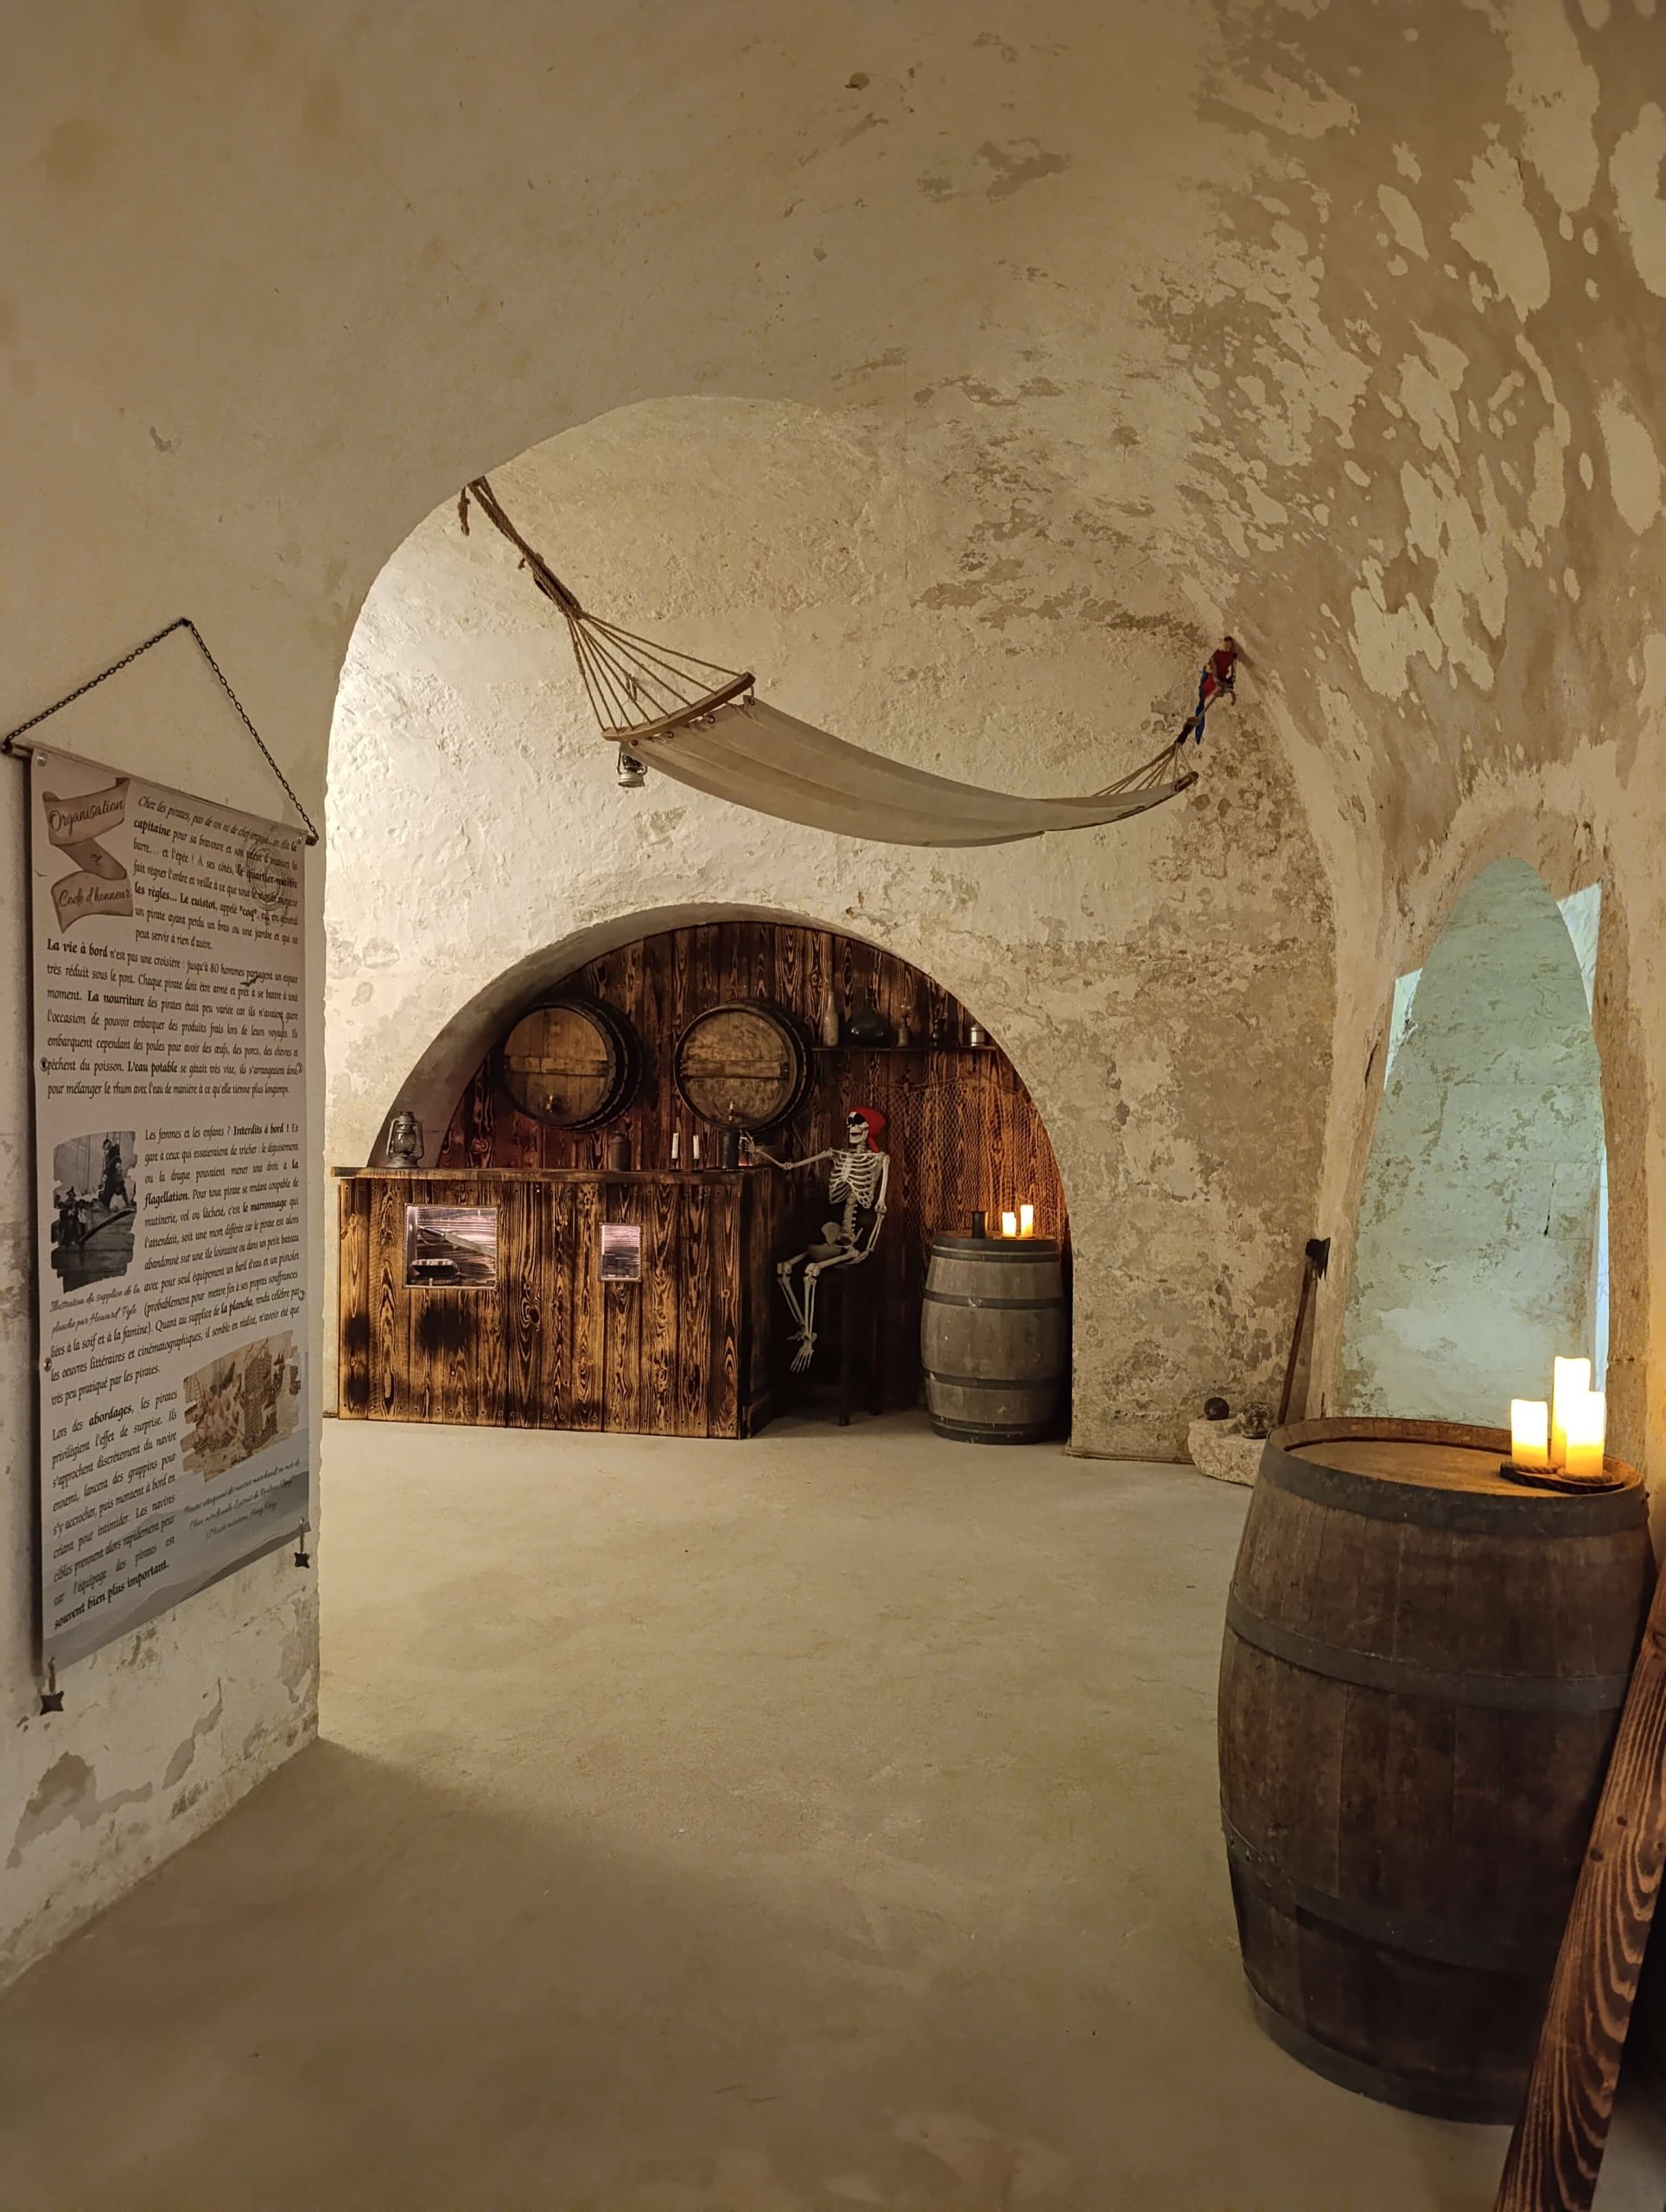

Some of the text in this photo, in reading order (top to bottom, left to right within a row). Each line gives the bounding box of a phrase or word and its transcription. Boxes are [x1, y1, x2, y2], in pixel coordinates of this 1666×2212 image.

[49, 800, 124, 836] Organisation
[134, 820, 169, 836] capitaine
[172, 831, 187, 842] pour
[199, 835, 223, 851] bravoure
[234, 847, 243, 857] son
[91, 854, 103, 866] et
[60, 887, 84, 906] Code
[135, 883, 144, 894] les
[180, 893, 188, 904] Le
[136, 930, 149, 942] peut
[151, 931, 169, 942] servir
[176, 935, 188, 944] rien
[191, 936, 212, 949] d'autre.
[47, 938, 60, 950] La
[62, 941, 77, 952] vie
[89, 944, 108, 957] bord
[110, 949, 124, 960] n'est
[127, 953, 137, 965] pas
[187, 960, 207, 975] jusqu'à
[210, 963, 217, 973] 80
[221, 963, 244, 976] hommes
[48, 989, 81, 1000] moment.
[87, 990, 99, 1001] La
[104, 995, 143, 1006] nourriture
[148, 995, 156, 1007] des
[161, 999, 181, 1013] pirates
[185, 1001, 198, 1011] était
[202, 1005, 212, 1016] peu
[48, 1009, 86, 1023] l'occasion
[92, 1013, 99, 1025] de
[104, 1017, 129, 1030] pouvoir
[133, 1017, 164, 1033] embarquer
[169, 1019, 177, 1030] des
[181, 1020, 206, 1035] produits
[209, 1021, 223, 1037] frais
[227, 1023, 237, 1034] lors
[251, 1025, 264, 1035] leurs
[48, 1034, 92, 1052] embarquent
[97, 1037, 130, 1052] cependant
[133, 1038, 143, 1050] des
[146, 1039, 164, 1054] poules
[168, 1044, 181, 1056] pour
[184, 1044, 199, 1052] avoir
[202, 1042, 212, 1052] des
[232, 1044, 241, 1054] des
[48, 1085, 64, 1098] pour
[67, 1082, 102, 1098] mélanger
[113, 1082, 130, 1093] rhum
[149, 1082, 162, 1093] l'eau
[173, 1084, 197, 1093] manière
[213, 1083, 231, 1097] qu'elle
[252, 1083, 263, 1096] plus
[145, 1129, 156, 1140] Les
[157, 1128, 181, 1143] femmes
[203, 1126, 224, 1140] enfants
[233, 1123, 262, 1135] Interdits
[270, 1122, 283, 1133] bord
[143, 1191, 189, 1209] flagellation.
[193, 1189, 207, 1198] Pour
[224, 1186, 239, 1199] pirate
[269, 1178, 289, 1192] coupable
[180, 1209, 189, 1221] vol
[228, 1205, 239, 1215] c'est
[251, 1200, 286, 1211] marronnage
[289, 1198, 298, 1209] qui
[50, 1345, 64, 1358] liées
[82, 1334, 95, 1351] soif
[122, 1322, 152, 1343] famine).
[156, 1319, 176, 1331] Quant
[188, 1308, 211, 1325] supplice
[229, 1296, 253, 1315] planche,
[290, 1288, 299, 1300] par
[51, 1365, 160, 1405] très peu pratiqué par les pirates.
[53, 1391, 177, 1440] Lors des abordages, les pirates
[53, 1432, 176, 1487] s'approchent discrètement du navire
[54, 1560, 169, 1629] souvent bien plus important.
